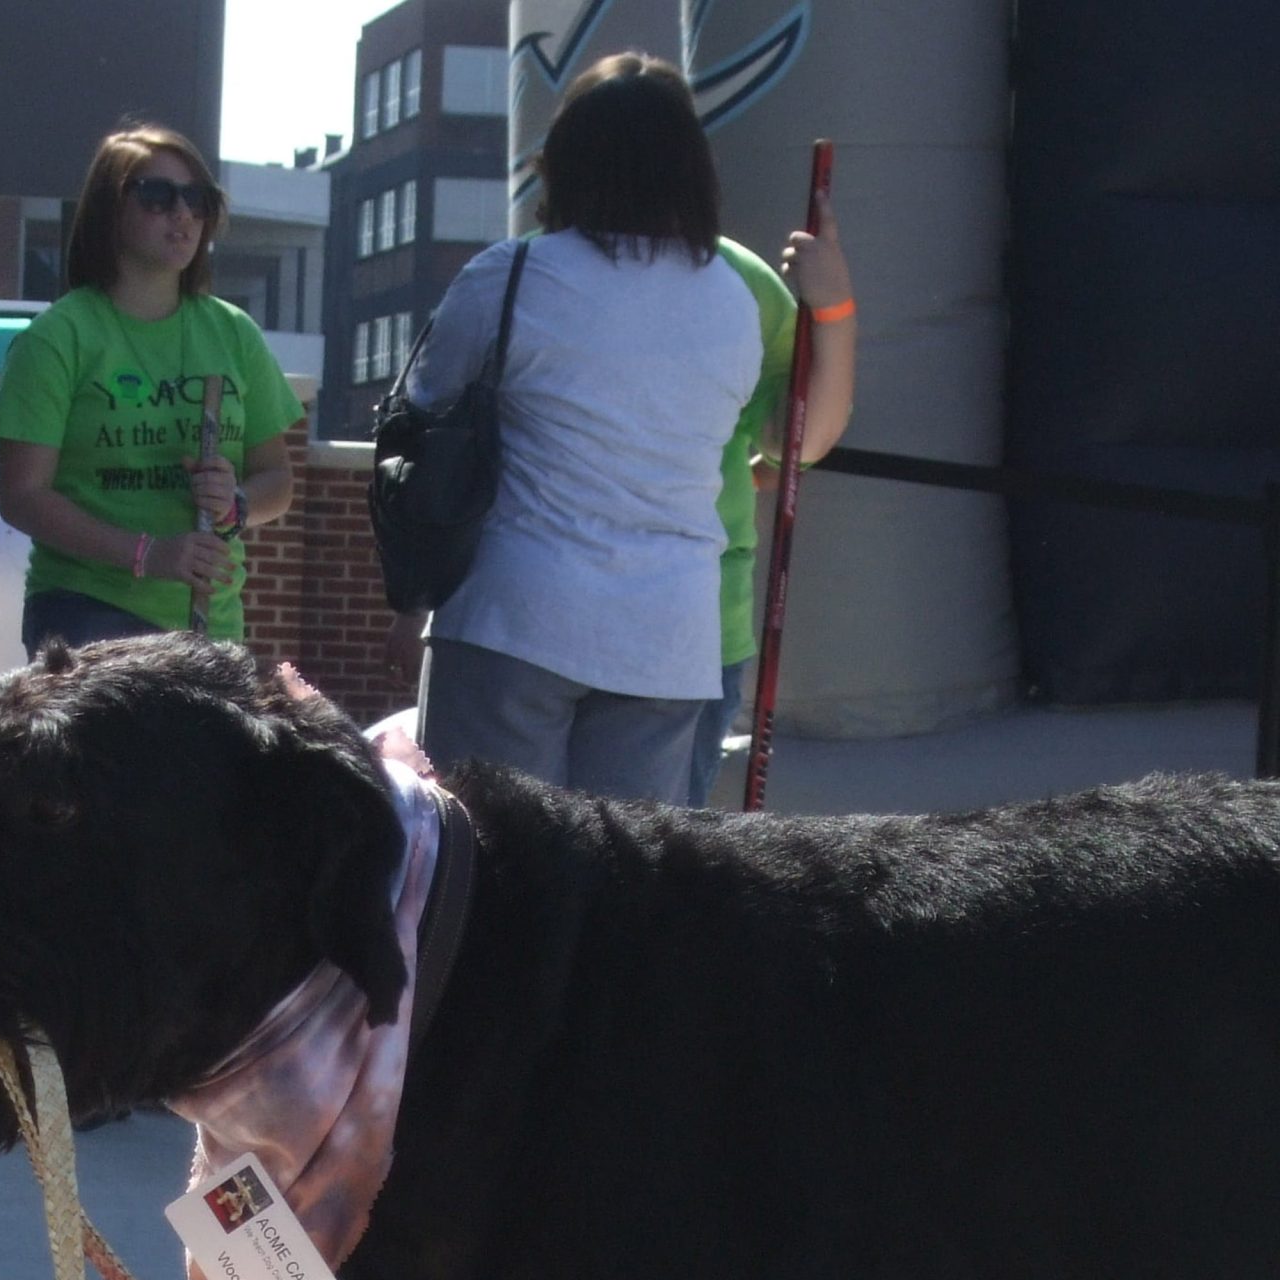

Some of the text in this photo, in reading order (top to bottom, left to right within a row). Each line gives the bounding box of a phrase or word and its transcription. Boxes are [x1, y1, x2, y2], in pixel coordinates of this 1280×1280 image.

[95, 423, 124, 448] At
[132, 420, 167, 445] the
[255, 1217, 292, 1262] ACME
